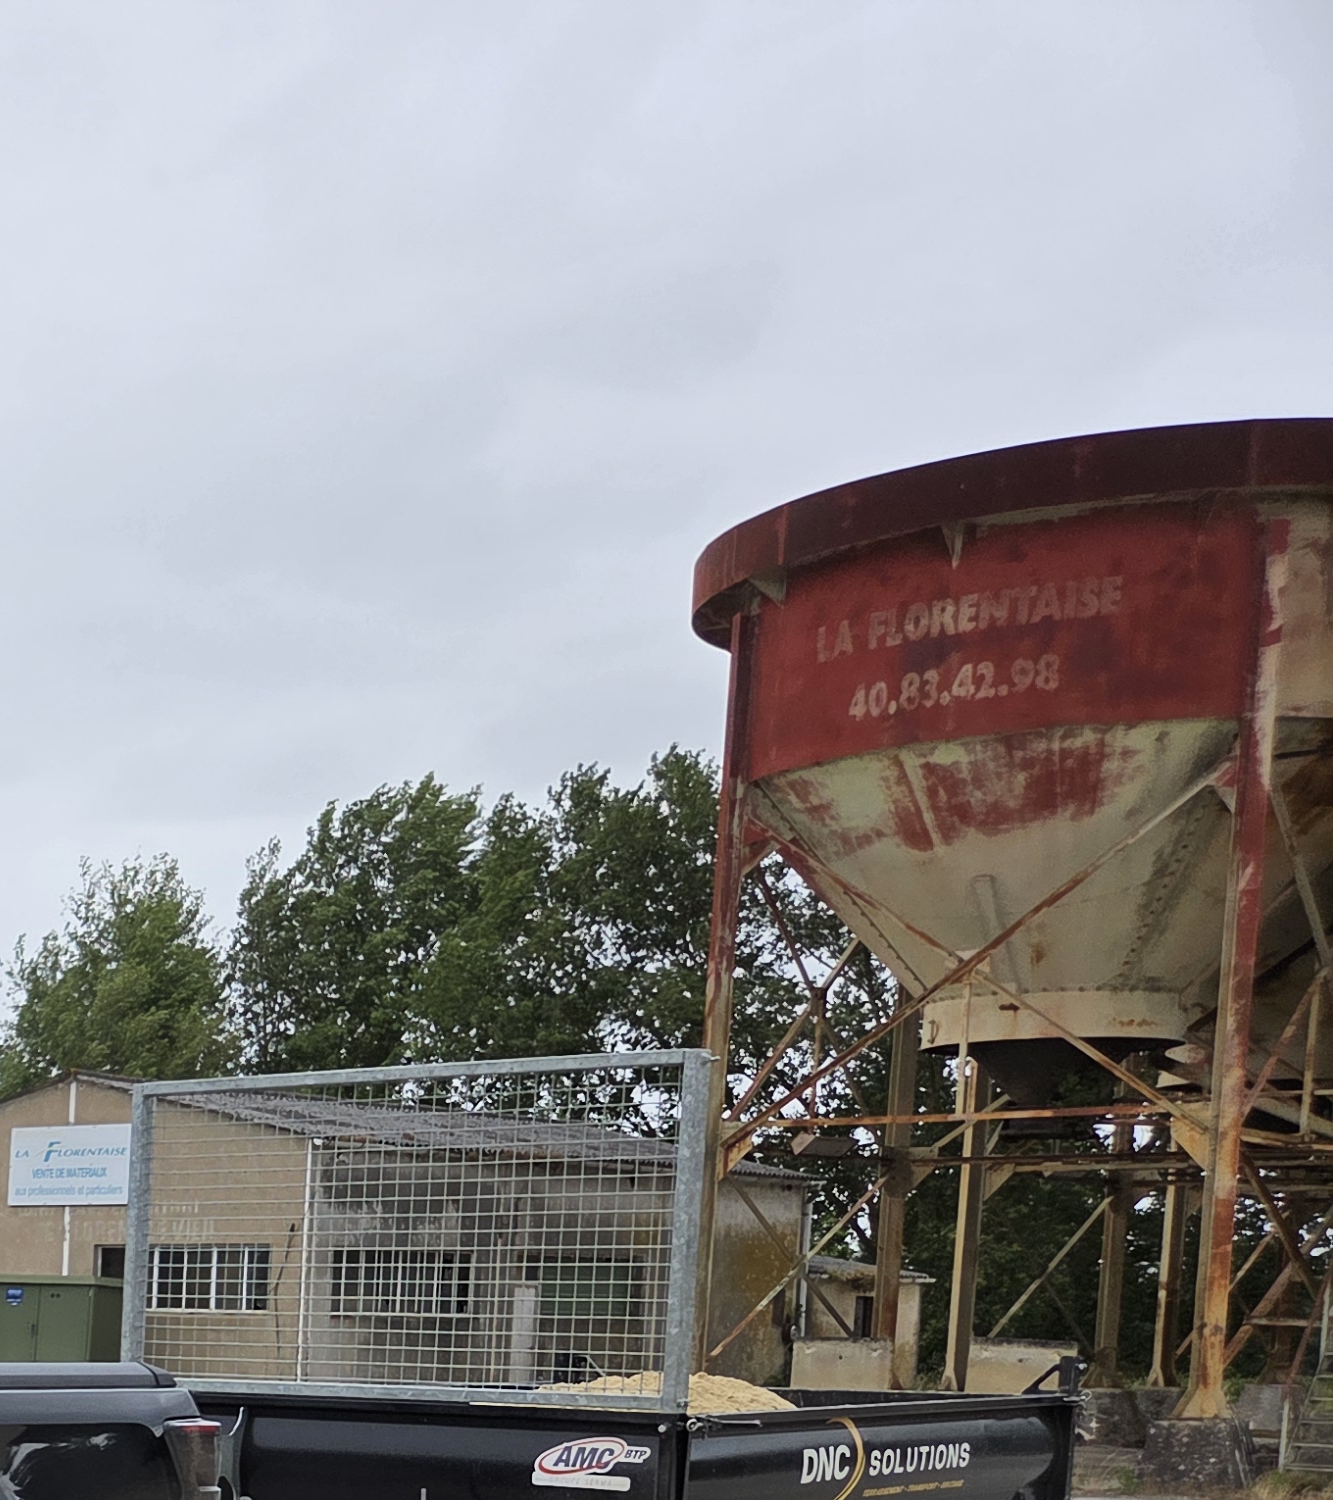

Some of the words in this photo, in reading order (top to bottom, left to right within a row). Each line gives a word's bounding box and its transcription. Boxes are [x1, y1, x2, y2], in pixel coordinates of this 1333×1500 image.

[816, 619, 854, 663] LA
[867, 575, 1123, 650] FLORENTAISE
[848, 653, 1060, 721] 40.83.42.98
[15, 1150, 30, 1159] LA
[43, 1141, 128, 1163] FLORENTAISE
[31, 1167, 54, 1180] VENTE
[55, 1167, 65, 1179] DE
[77, 1184, 85, 1196] et
[553, 1446, 615, 1470] AMC
[624, 1449, 647, 1460] BTP
[800, 1444, 851, 1484] DNC
[869, 1442, 971, 1477] SOLUTIONS
